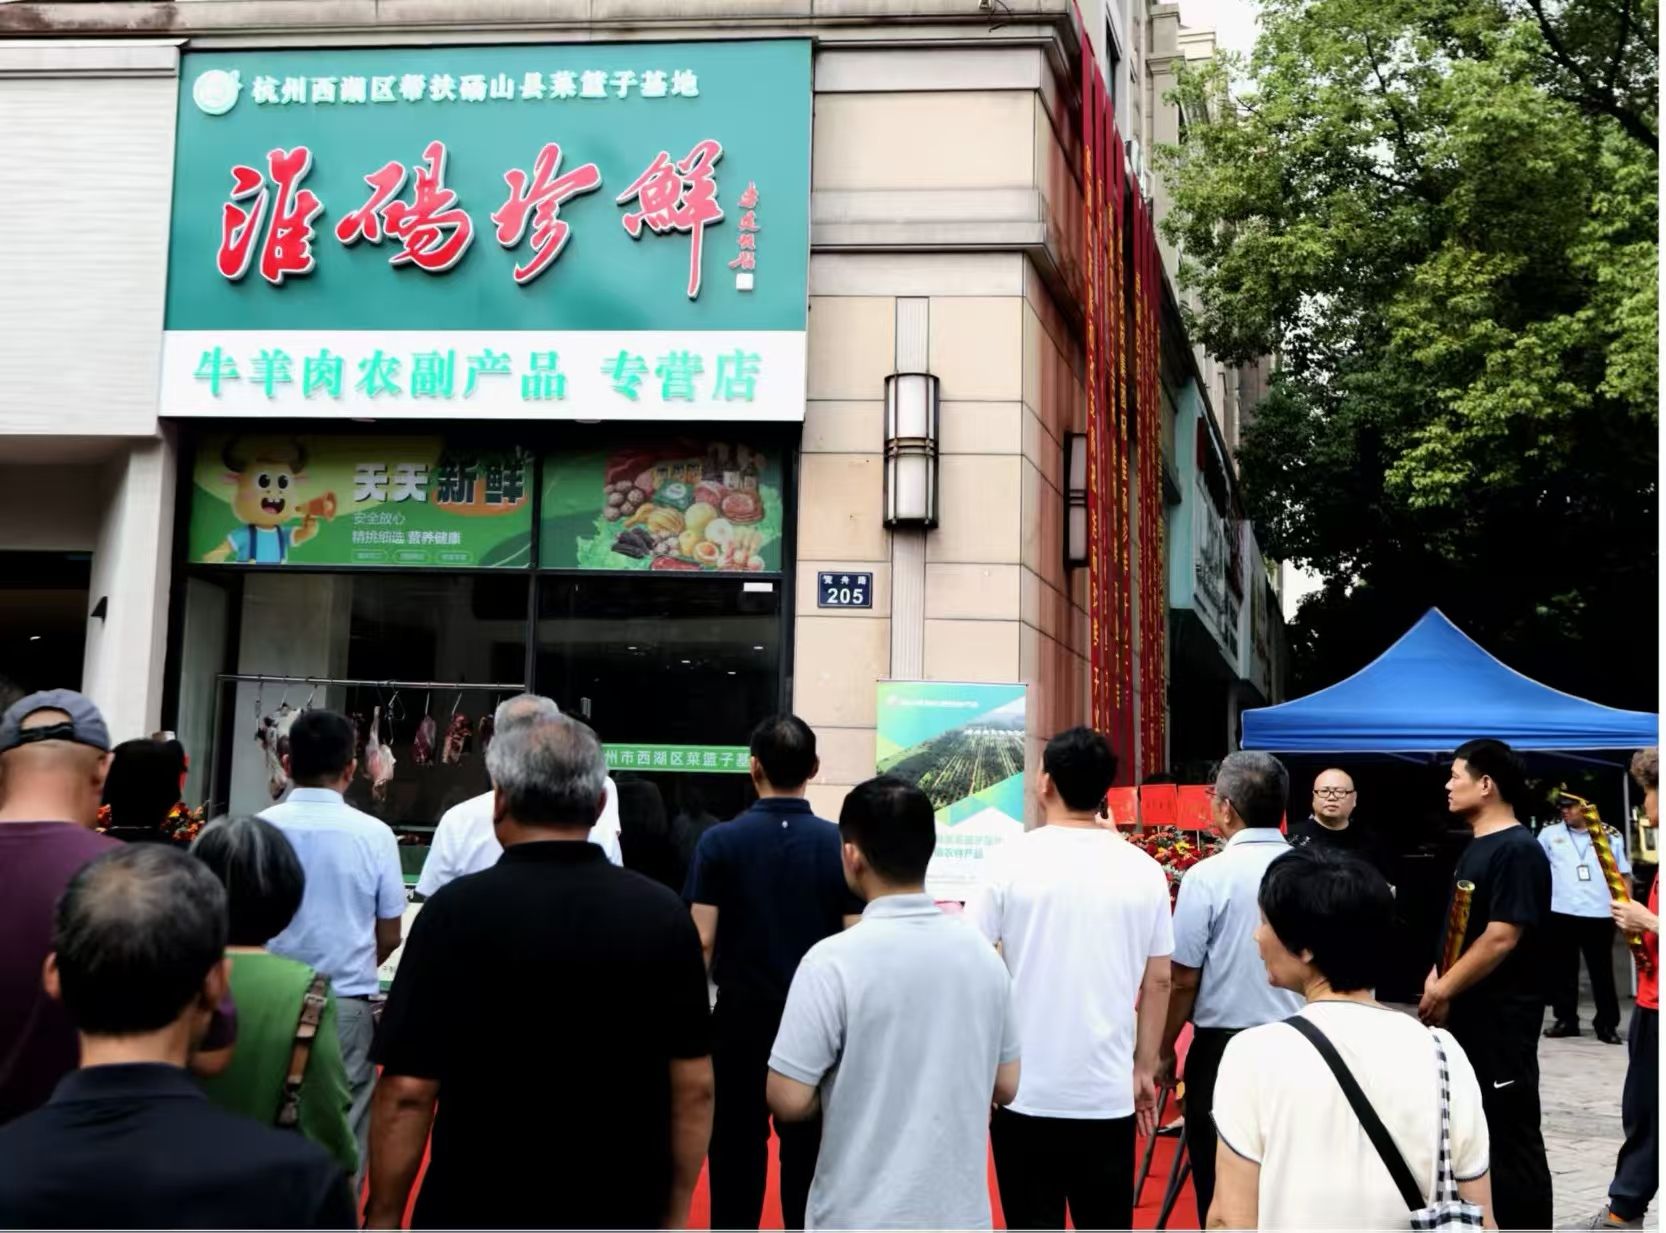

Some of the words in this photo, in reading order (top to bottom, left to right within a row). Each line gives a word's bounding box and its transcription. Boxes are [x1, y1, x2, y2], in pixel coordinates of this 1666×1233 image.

[252, 69, 700, 104] 杭州西湖区帮扶砀山县菜篮子基地
[194, 345, 569, 400] 牛羊肉农副产品
[600, 349, 763, 402] 专营店
[353, 511, 406, 525] 安全放心
[352, 530, 404, 545] 精挑细选
[407, 530, 461, 545] 营养健康
[826, 587, 863, 604] 205
